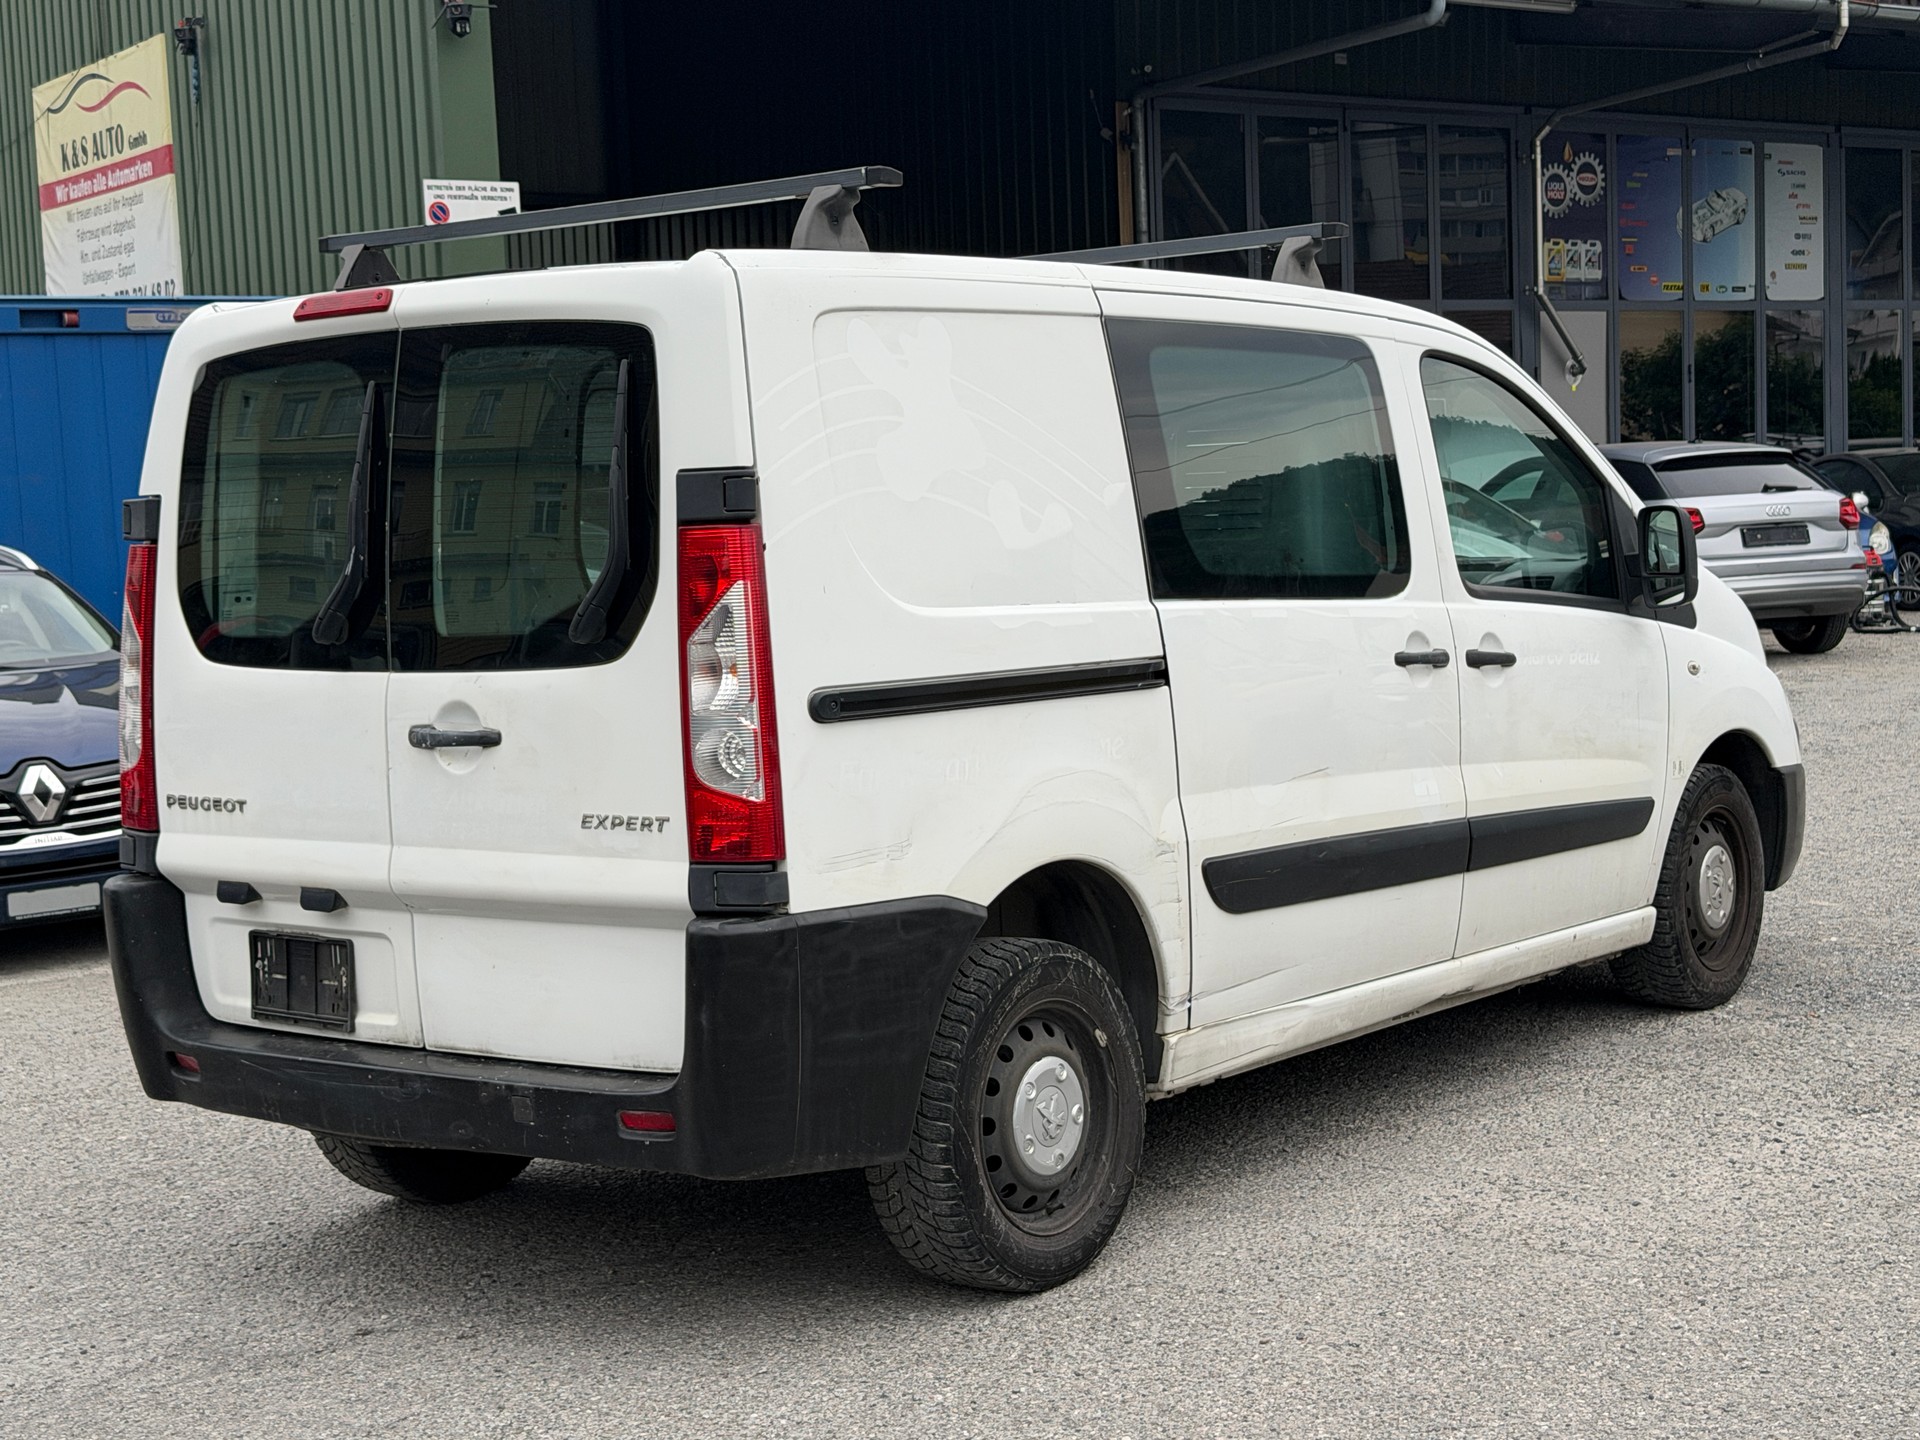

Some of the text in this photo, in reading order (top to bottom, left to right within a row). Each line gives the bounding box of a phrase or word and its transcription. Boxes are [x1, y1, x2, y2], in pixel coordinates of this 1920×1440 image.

[92, 123, 125, 163] AUTO
[55, 160, 153, 204] Wir kaufen alle Automarken
[1547, 182, 1565, 191] LIQUI
[1547, 190, 1565, 199] MOLY
[165, 793, 248, 815] PEUGEOT
[580, 812, 670, 833] EXPERT
